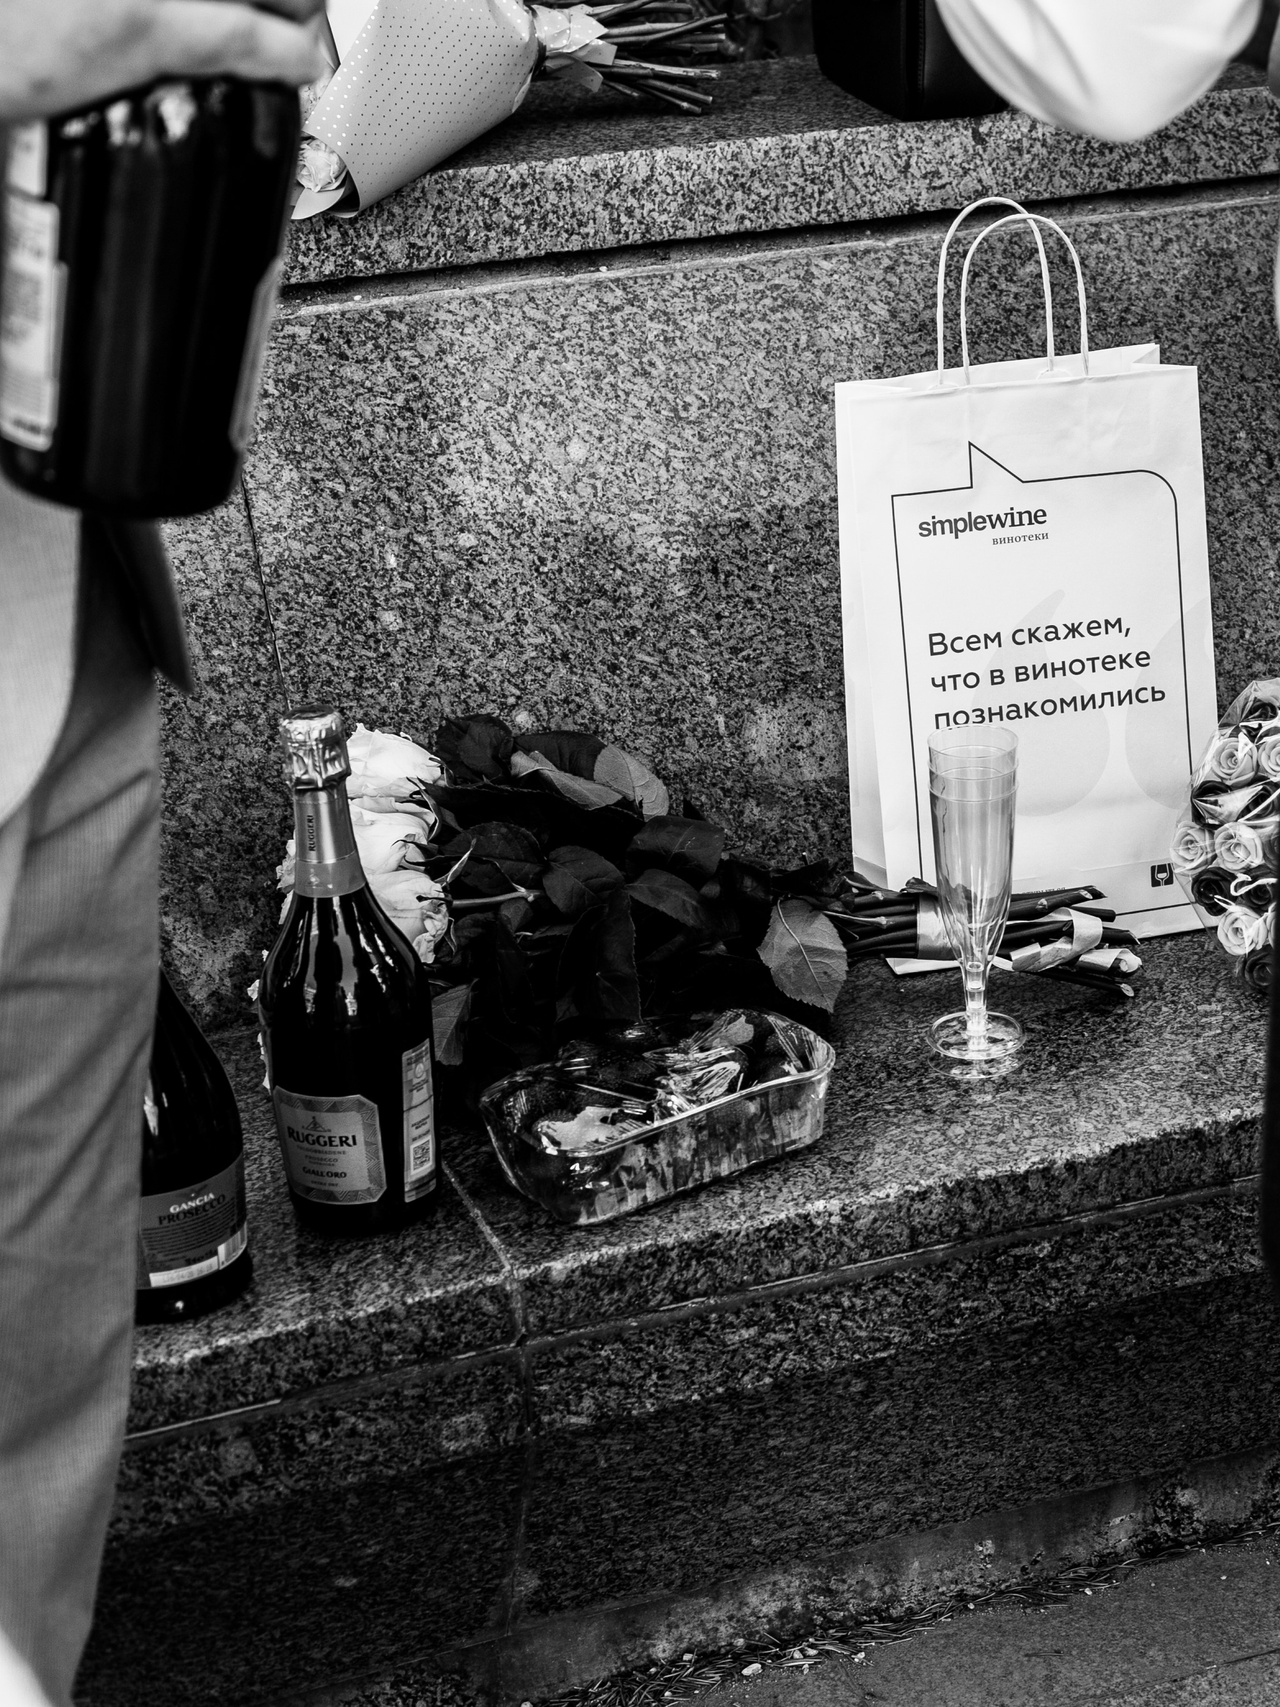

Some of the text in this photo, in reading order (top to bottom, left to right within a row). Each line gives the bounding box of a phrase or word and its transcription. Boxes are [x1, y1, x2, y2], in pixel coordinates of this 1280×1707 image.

[918, 506, 1048, 540] simplewine
[992, 532, 1049, 546] винотеки
[928, 617, 1131, 657] Всем скажем,
[931, 650, 1151, 692] что в винотеке
[934, 685, 1167, 730] познакомились
[307, 814, 316, 852] RUGGERI
[286, 1125, 357, 1148] RUGGERI
[158, 1194, 226, 1226] PROSECCO
[169, 1192, 215, 1214] GANCIA
